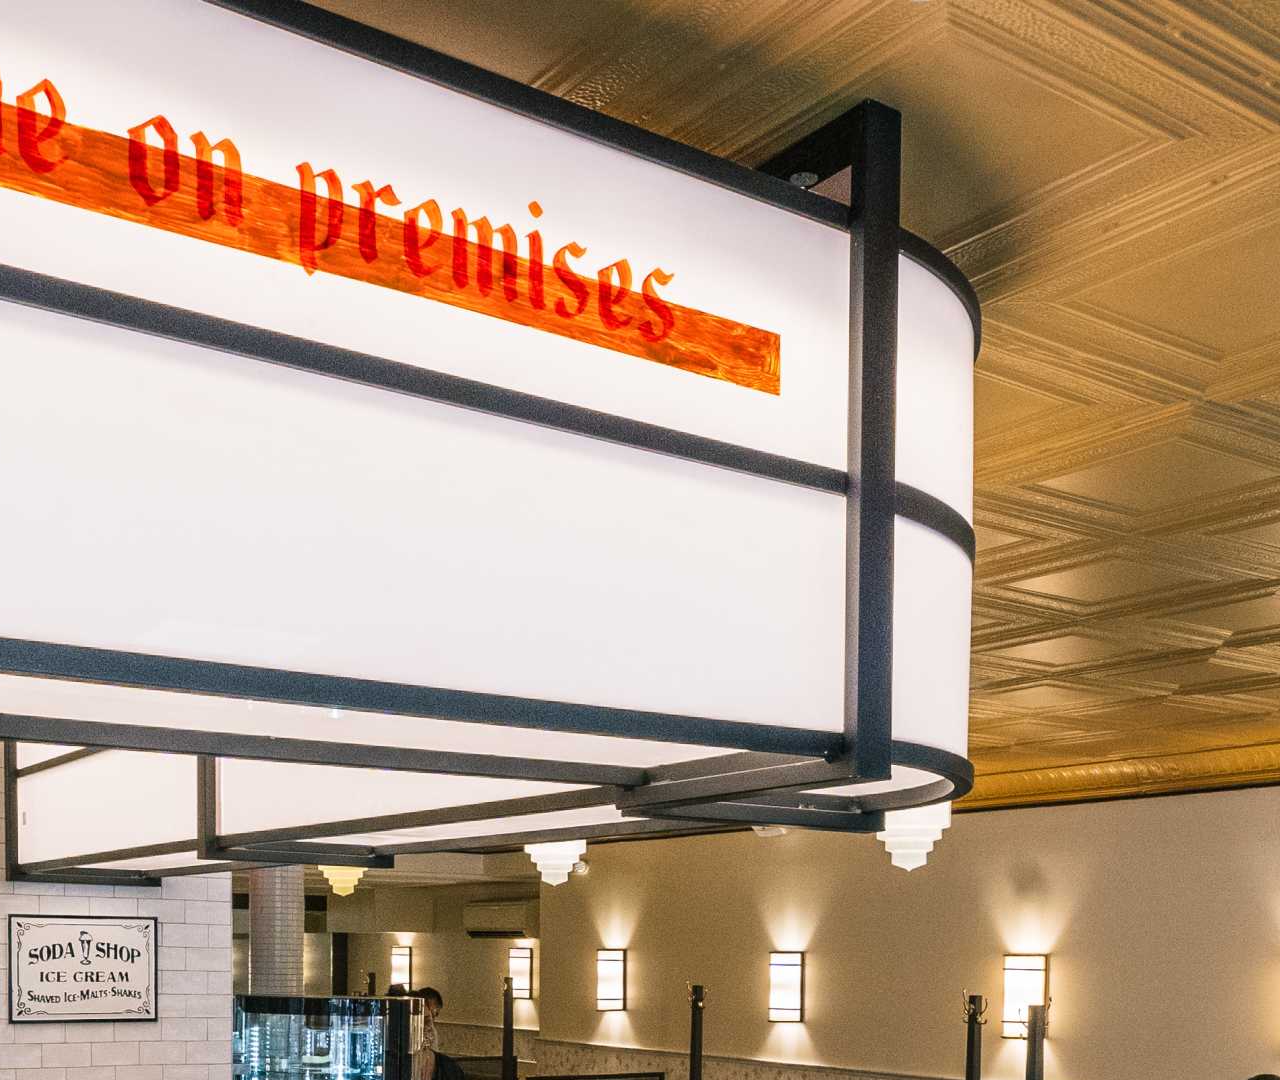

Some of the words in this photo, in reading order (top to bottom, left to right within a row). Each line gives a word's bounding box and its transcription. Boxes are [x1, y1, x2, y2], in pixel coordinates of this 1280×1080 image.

[128, 114, 244, 227] on
[296, 161, 674, 343] premises
[28, 942, 75, 965] SODA
[95, 942, 141, 964] SHOP
[39, 971, 67, 983] ICE
[73, 971, 129, 983] CREAM
